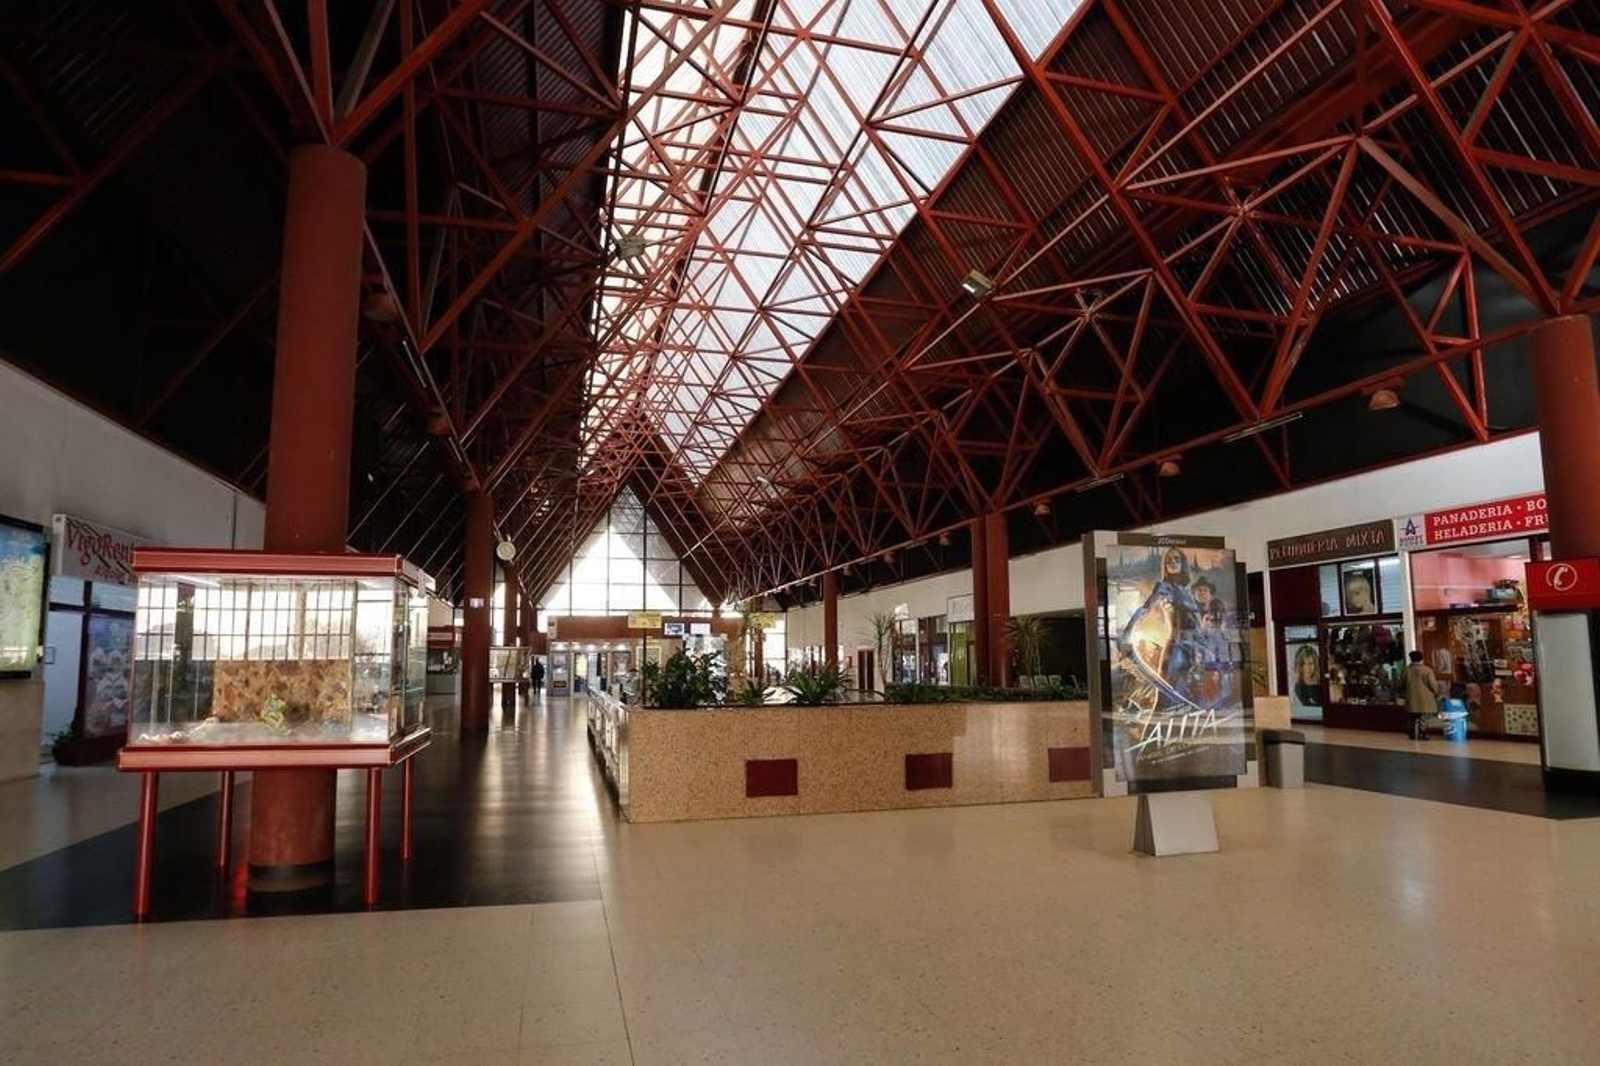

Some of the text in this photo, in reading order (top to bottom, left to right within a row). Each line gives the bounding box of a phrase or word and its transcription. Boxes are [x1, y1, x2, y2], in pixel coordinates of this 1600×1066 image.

[1433, 504, 1513, 526] PANADERIA
[1345, 530, 1386, 548] MIXTA
[1434, 519, 1513, 540] HELADERIA
[1124, 708, 1238, 752] ALITA
